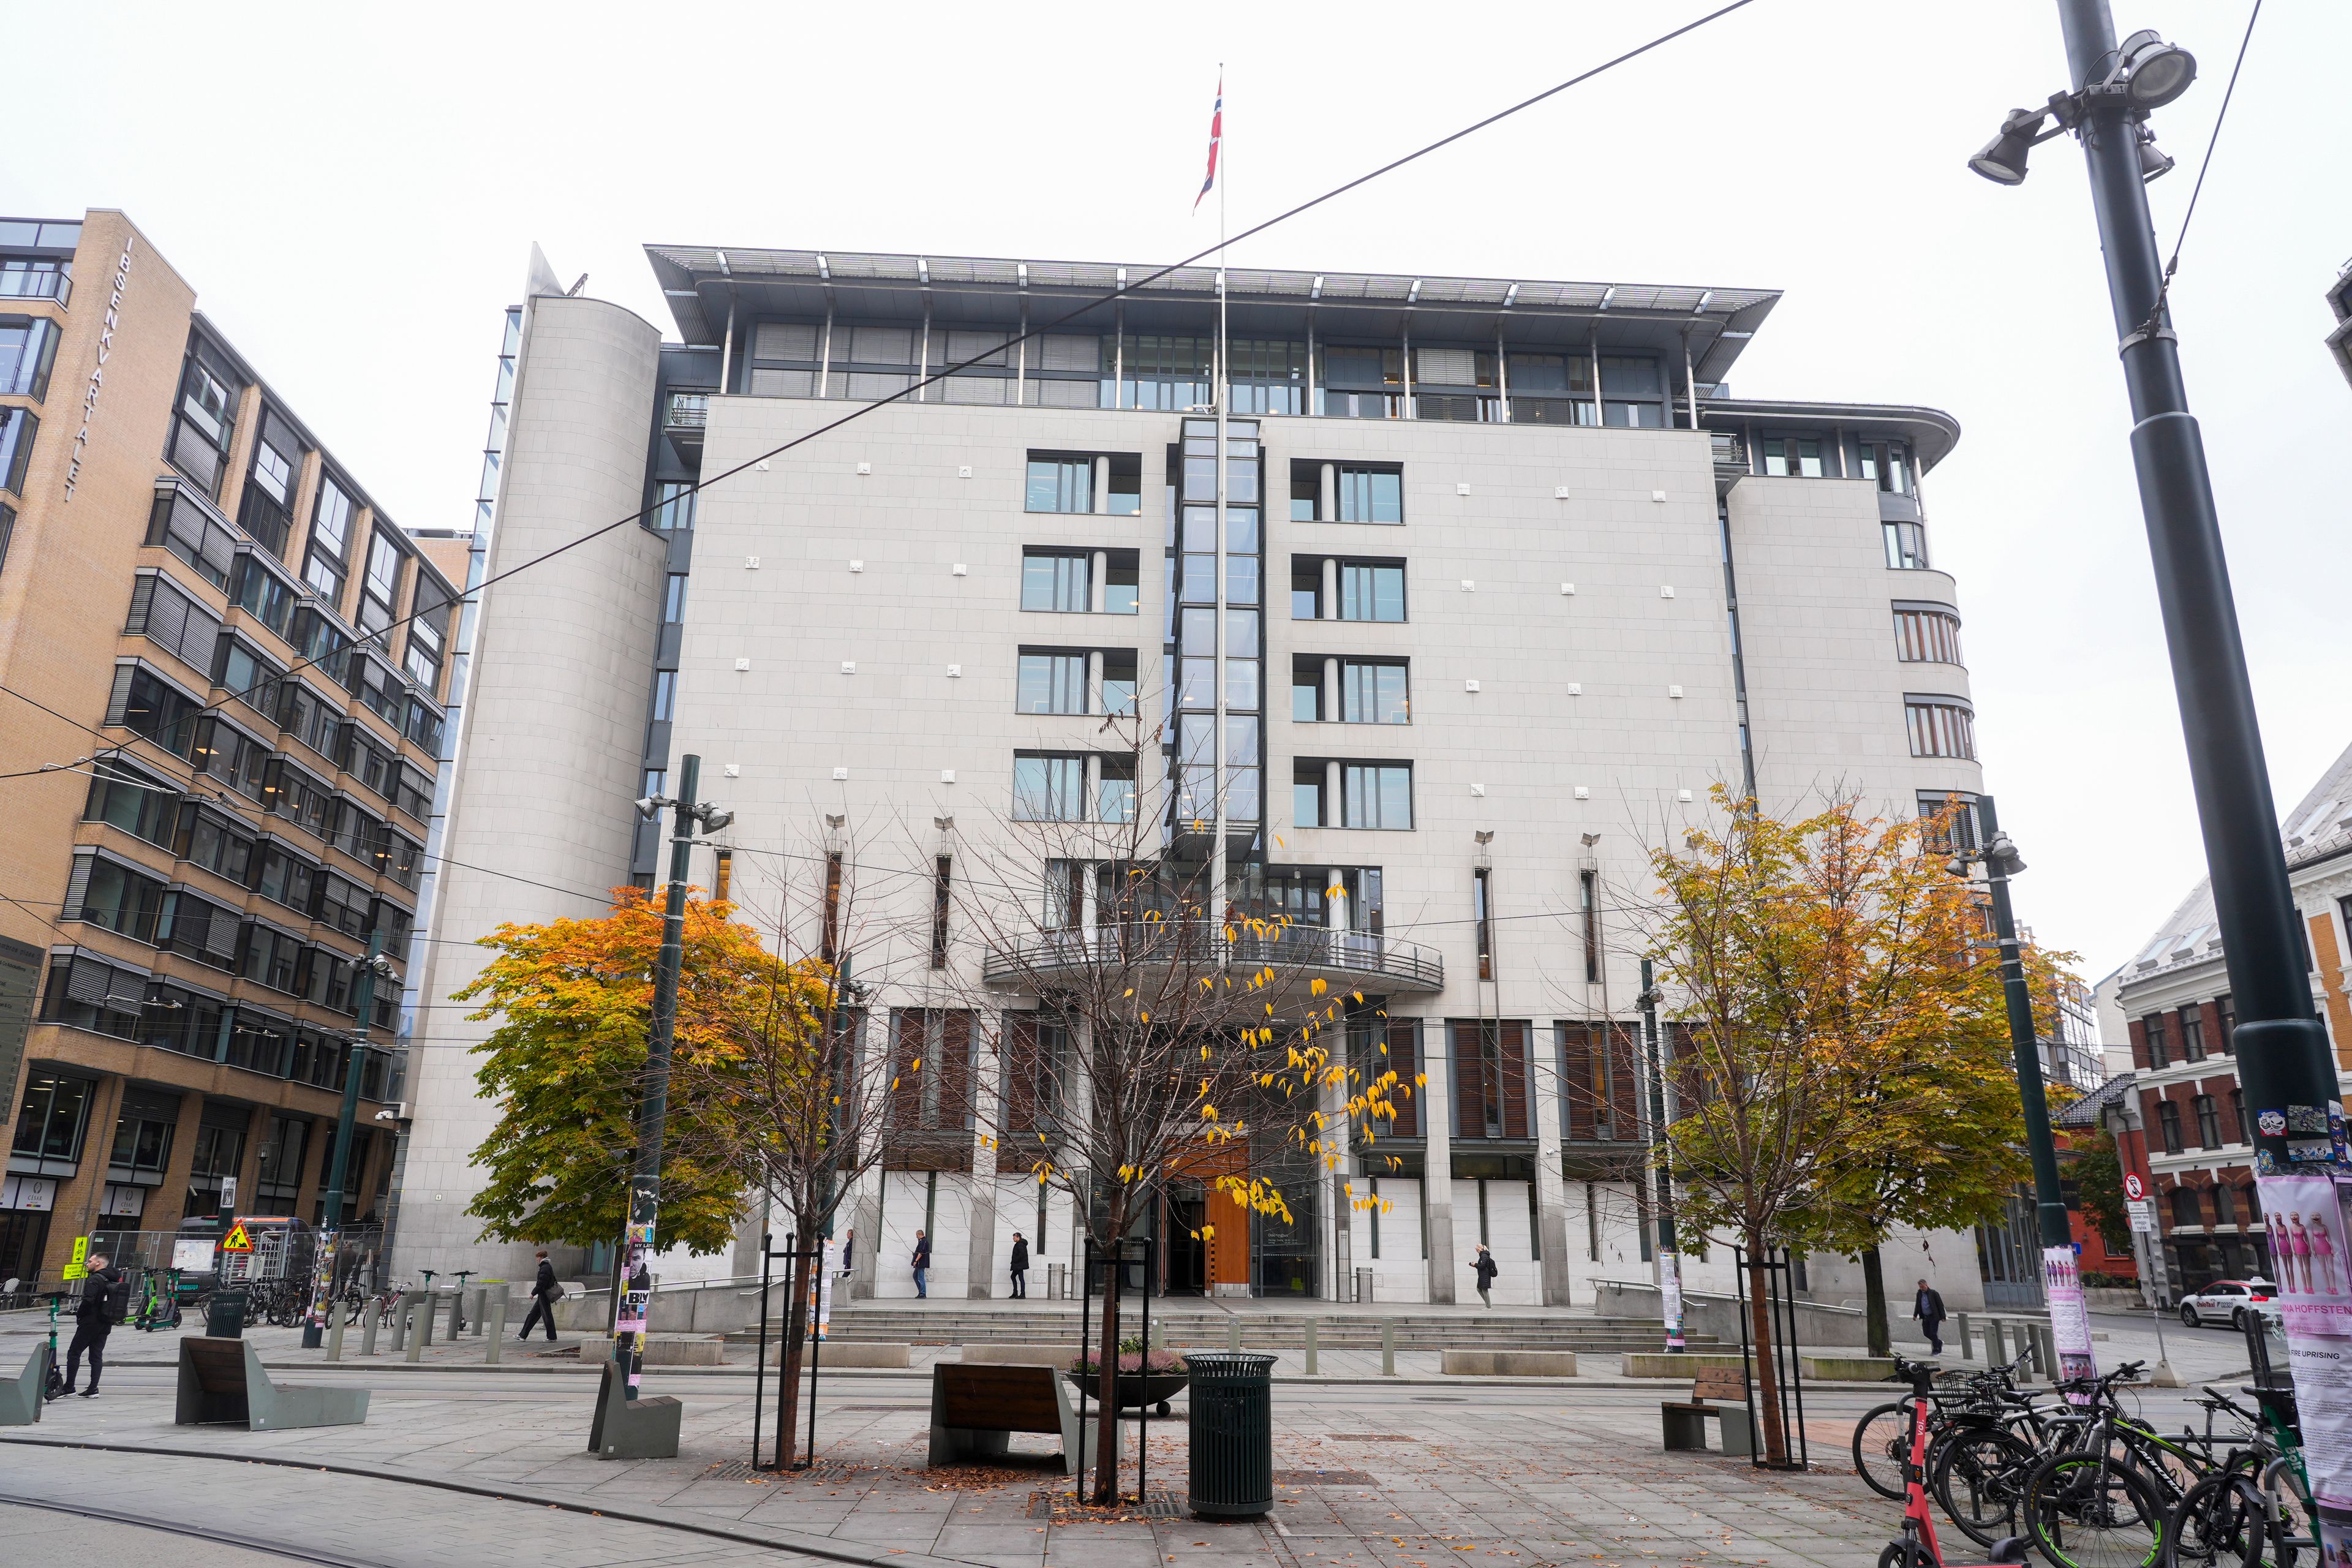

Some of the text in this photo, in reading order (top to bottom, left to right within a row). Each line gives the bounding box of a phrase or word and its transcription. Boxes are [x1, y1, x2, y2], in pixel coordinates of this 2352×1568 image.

[65, 236, 133, 502] IBSENKVARTALET
[628, 1292, 649, 1304] BLY
[2294, 1305, 2352, 1314] HOFFSTEN
[2302, 1351, 2340, 1360] UPRISING
[2285, 1446, 2303, 1470] Bolt
